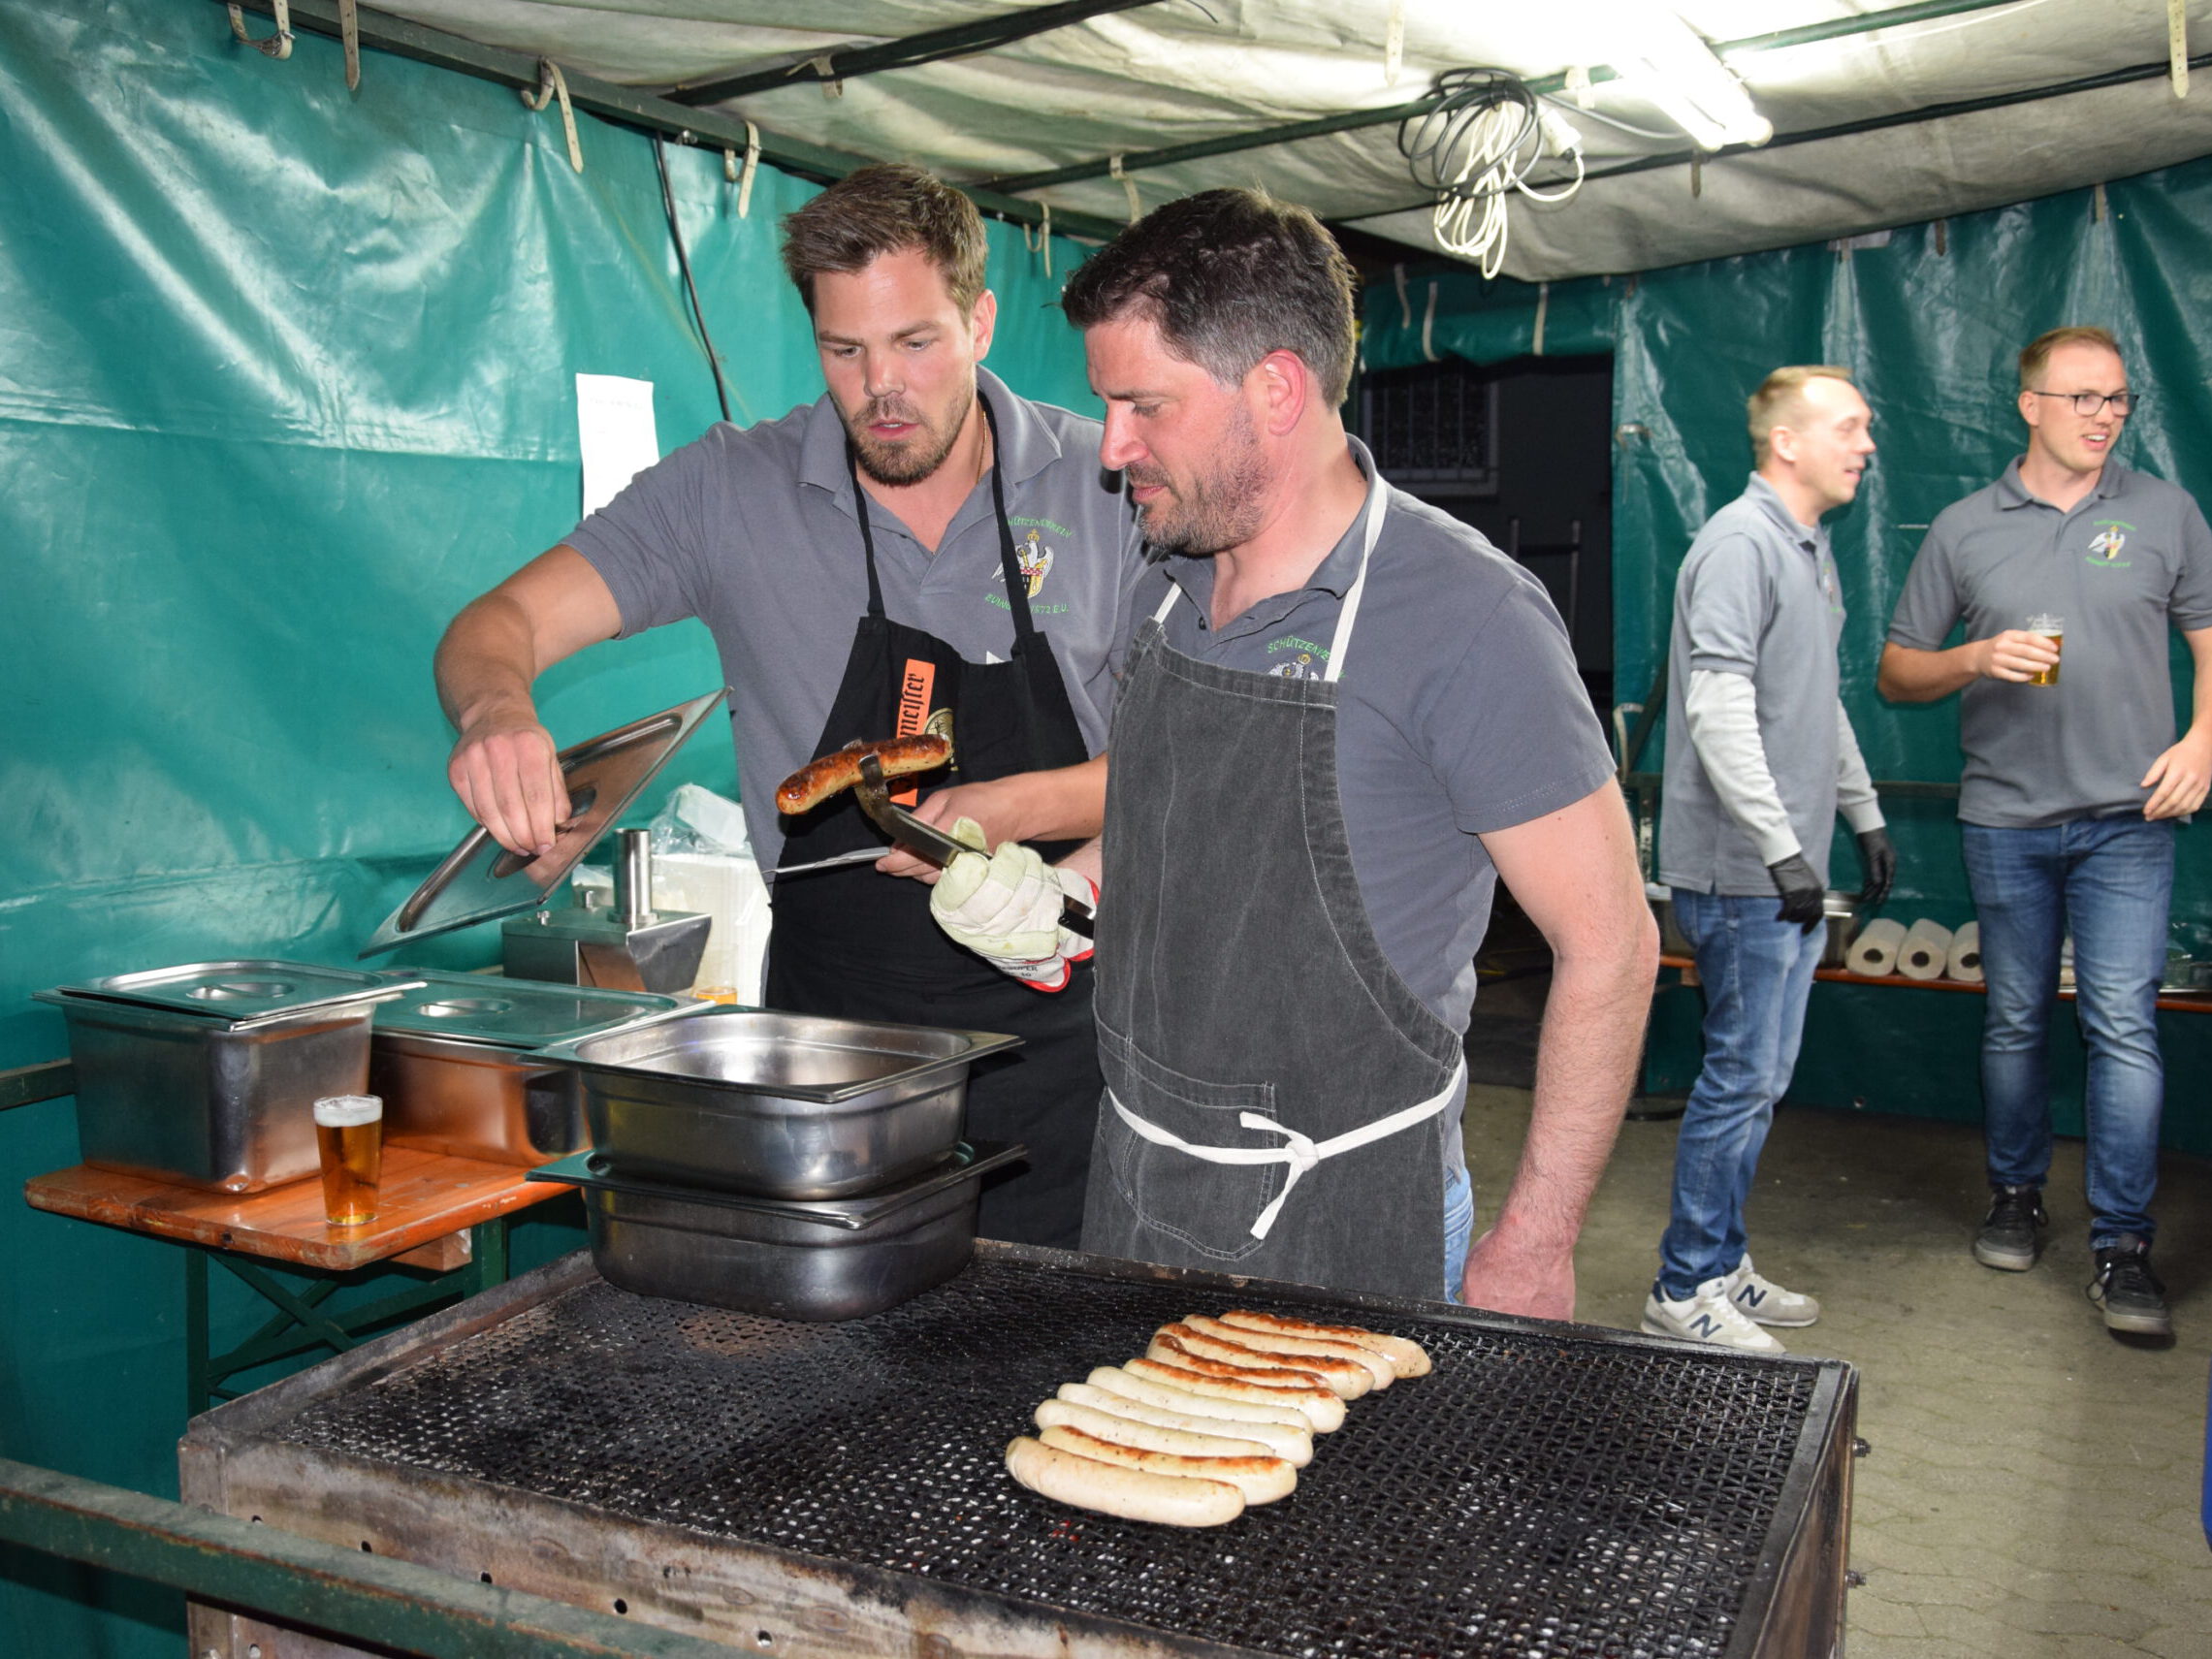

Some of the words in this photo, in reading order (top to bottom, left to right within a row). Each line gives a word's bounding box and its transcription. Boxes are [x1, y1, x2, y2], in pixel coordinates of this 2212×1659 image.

[900, 673, 924, 736] meister
[1737, 1284, 1768, 1308] N
[1689, 1314, 1722, 1339] N
